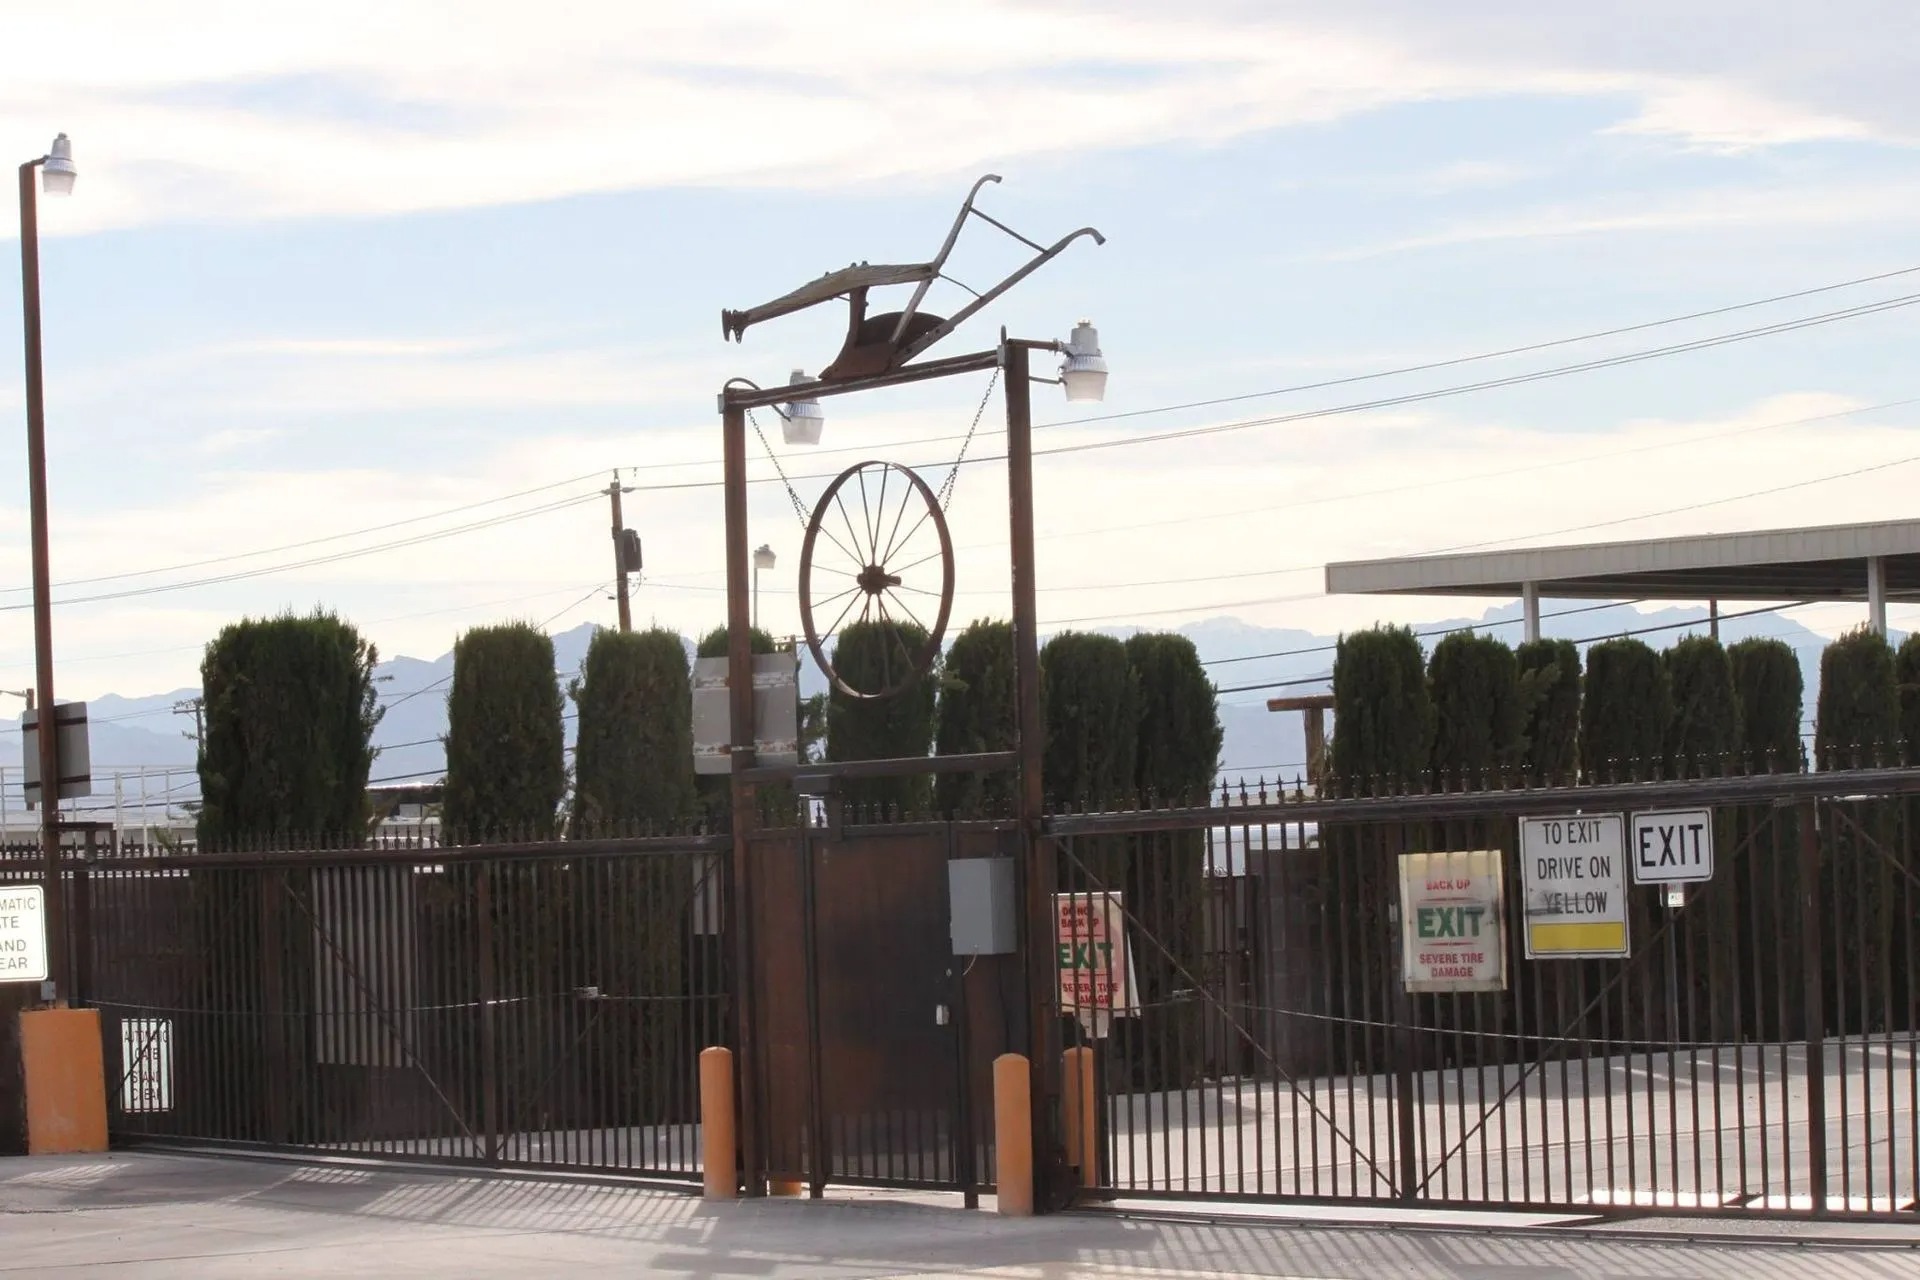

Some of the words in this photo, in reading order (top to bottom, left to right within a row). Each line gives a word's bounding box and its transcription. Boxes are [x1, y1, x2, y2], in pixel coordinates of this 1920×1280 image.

[1543, 822, 1562, 845] TO
[1567, 820, 1602, 844] EXIT
[1639, 824, 1703, 867] EXIT
[1537, 857, 1584, 879] DRIVE
[1589, 856, 1611, 878] ON
[1457, 879, 1471, 890] UP
[1543, 891, 1608, 914] YELLOW
[0, 916, 20, 928] TE
[1417, 906, 1485, 938] EXIT
[1419, 952, 1458, 964] SEVERE
[1461, 952, 1484, 963] TIRE
[1431, 967, 1474, 977] DAMAGE
